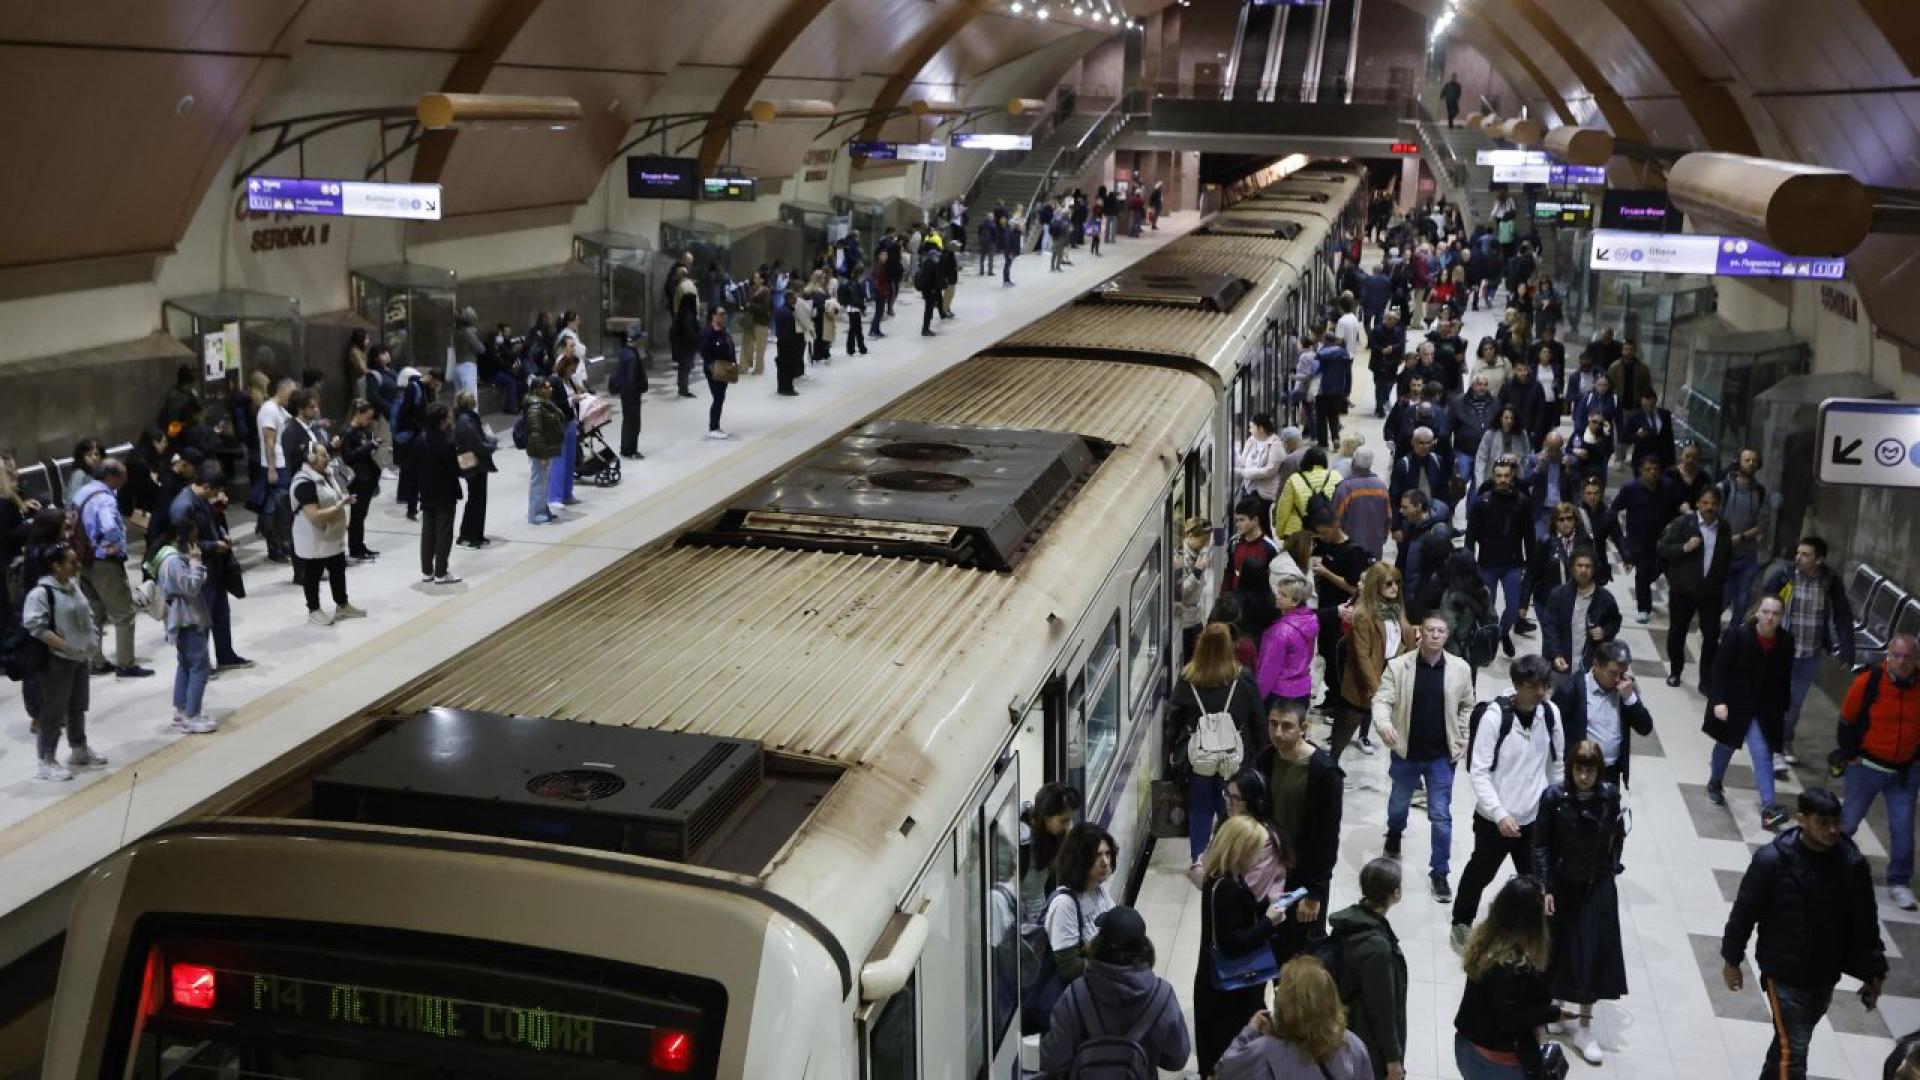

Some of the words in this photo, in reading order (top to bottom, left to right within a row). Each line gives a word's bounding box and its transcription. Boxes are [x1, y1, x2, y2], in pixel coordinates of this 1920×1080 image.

[251, 225, 315, 251] SERDIKA
[329, 984, 467, 1039] ЛЕТИЩЕ
[483, 1003, 595, 1053] СОФИЯ
